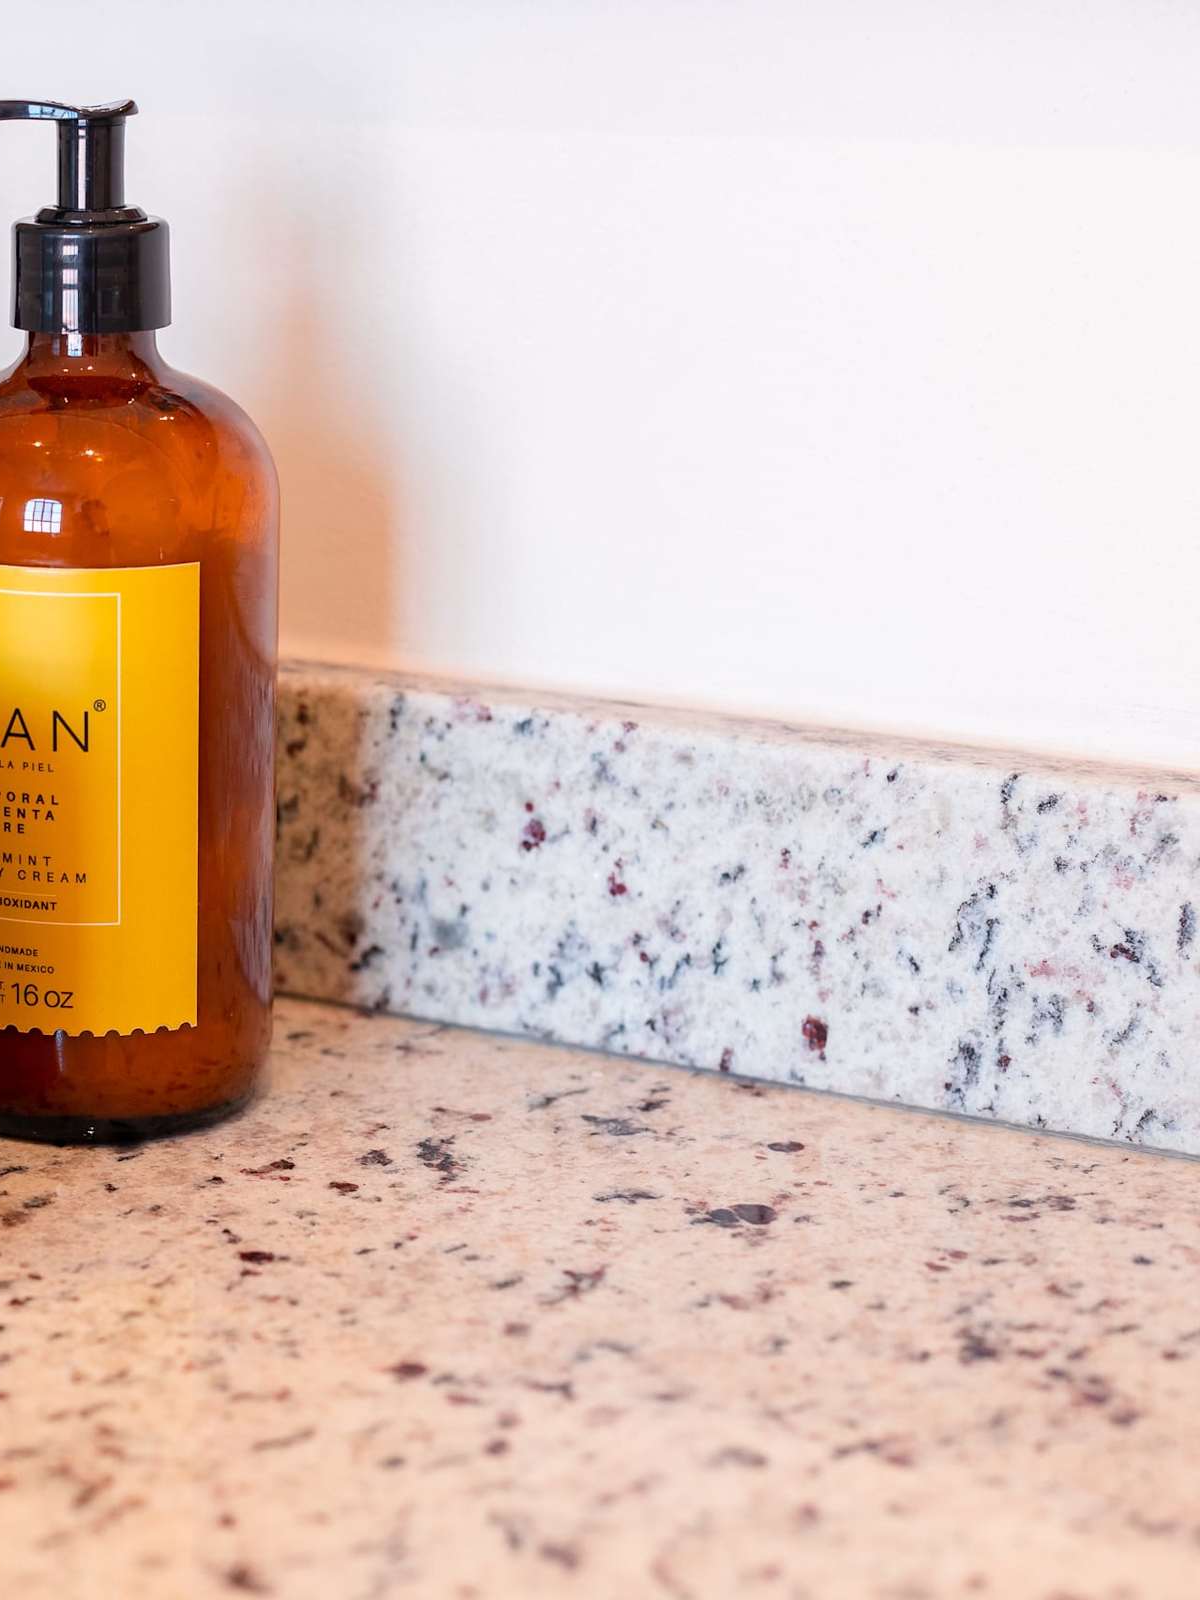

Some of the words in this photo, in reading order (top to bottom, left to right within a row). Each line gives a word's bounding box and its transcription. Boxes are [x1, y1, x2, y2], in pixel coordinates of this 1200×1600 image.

[0, 759, 14, 769] LA
[23, 761, 54, 772] PIEL
[2, 853, 51, 866] MINT
[17, 869, 86, 883] CREAM
[4, 961, 13, 970] IN
[17, 963, 55, 974] MEXICO
[11, 982, 39, 1007] 16
